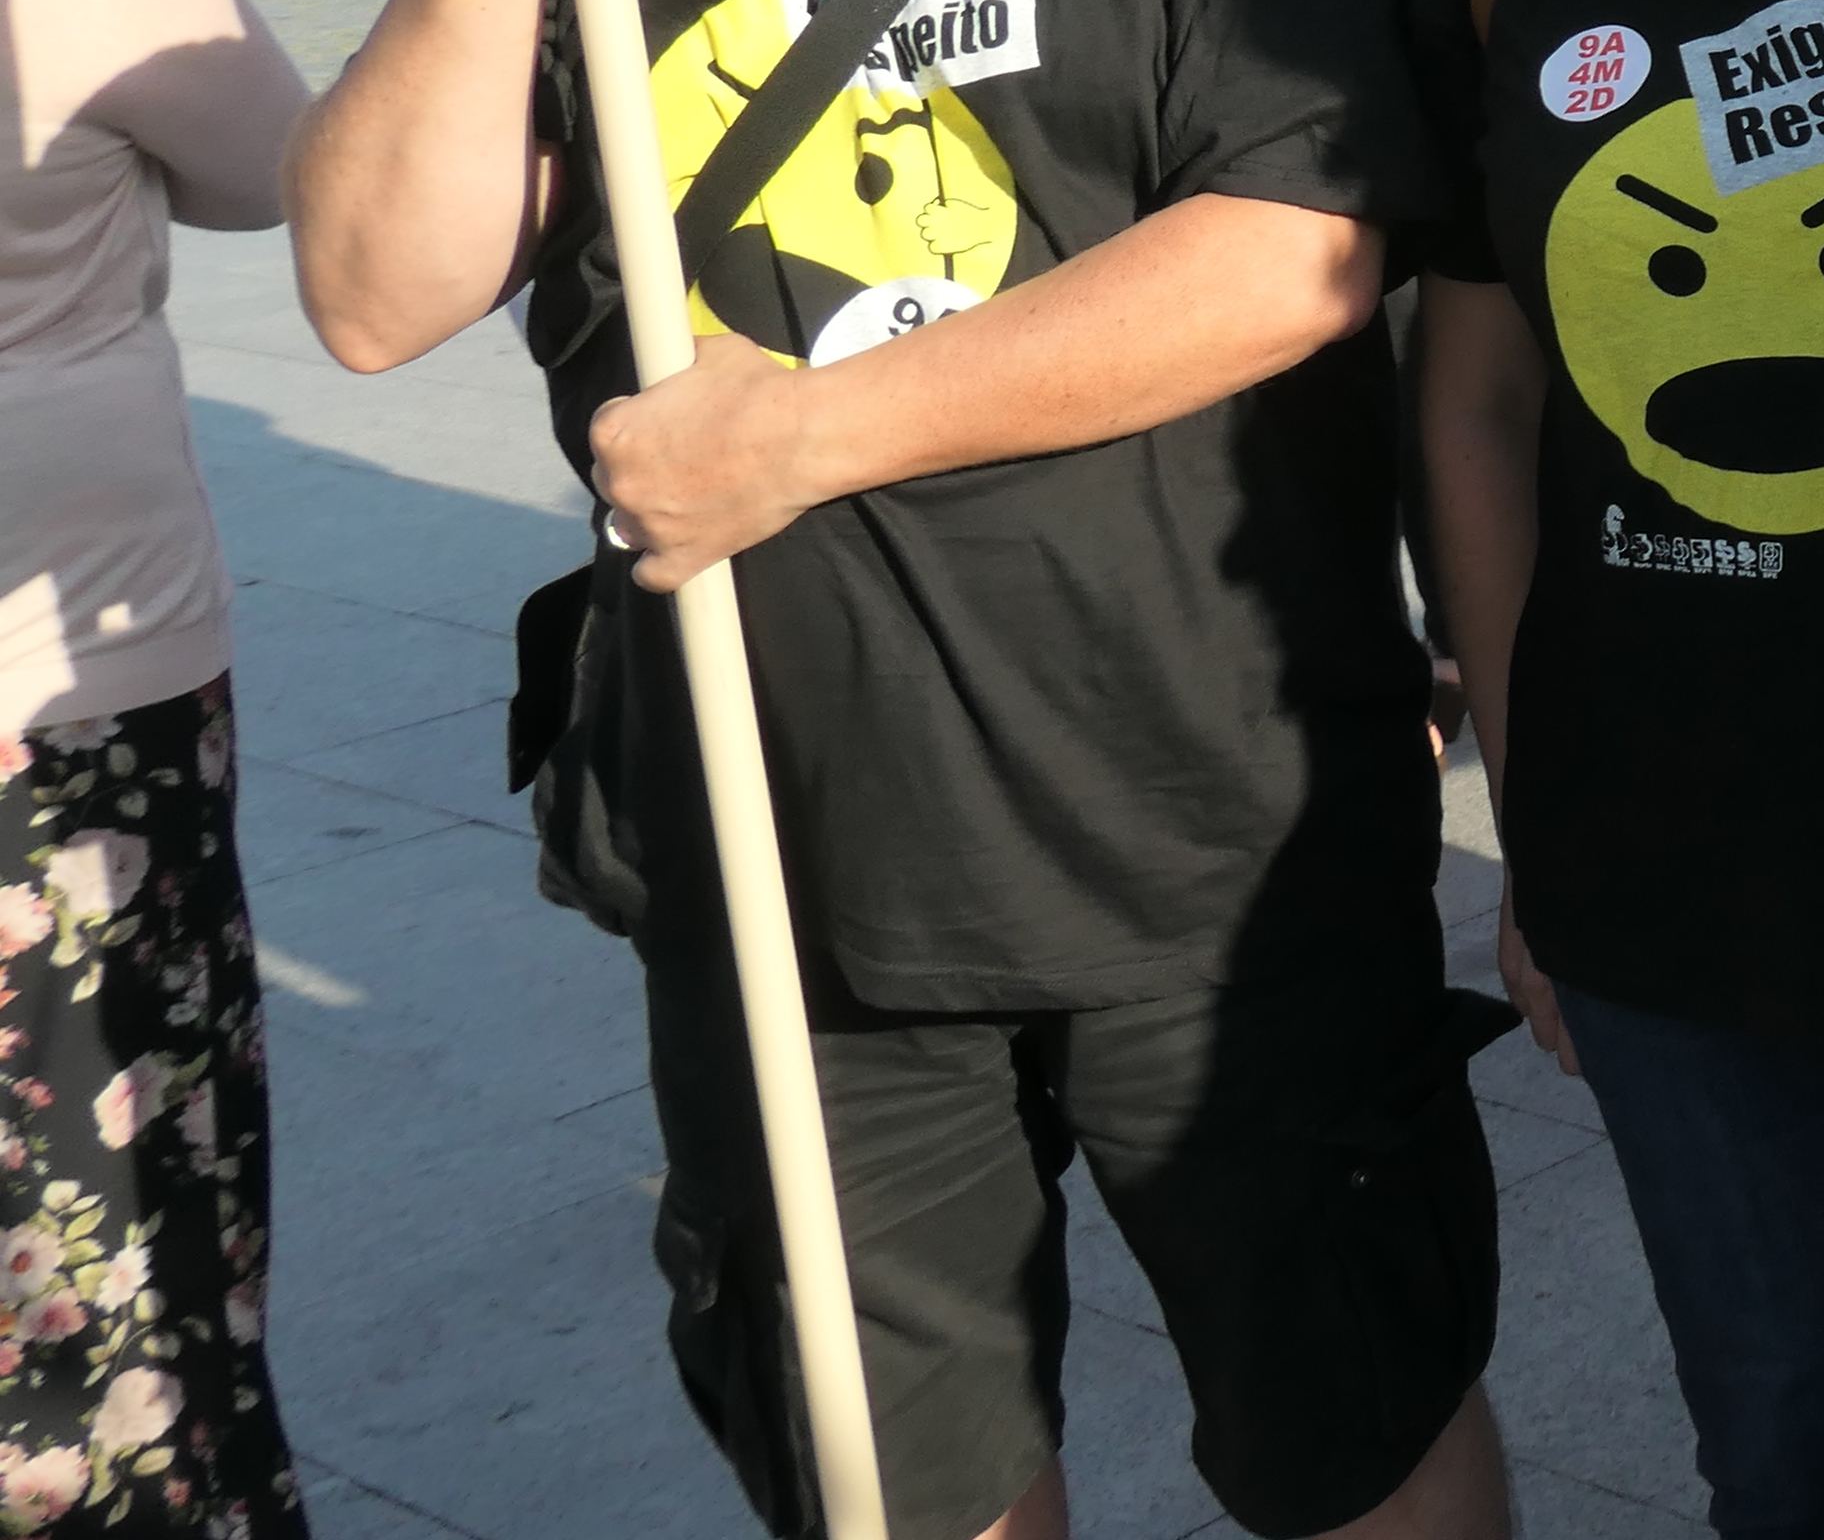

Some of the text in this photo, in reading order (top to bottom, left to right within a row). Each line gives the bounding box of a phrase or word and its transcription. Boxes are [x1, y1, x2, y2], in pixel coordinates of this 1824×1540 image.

[1578, 31, 1626, 58] 9A
[1567, 61, 1623, 85] 4M
[1564, 89, 1615, 114] 2D
